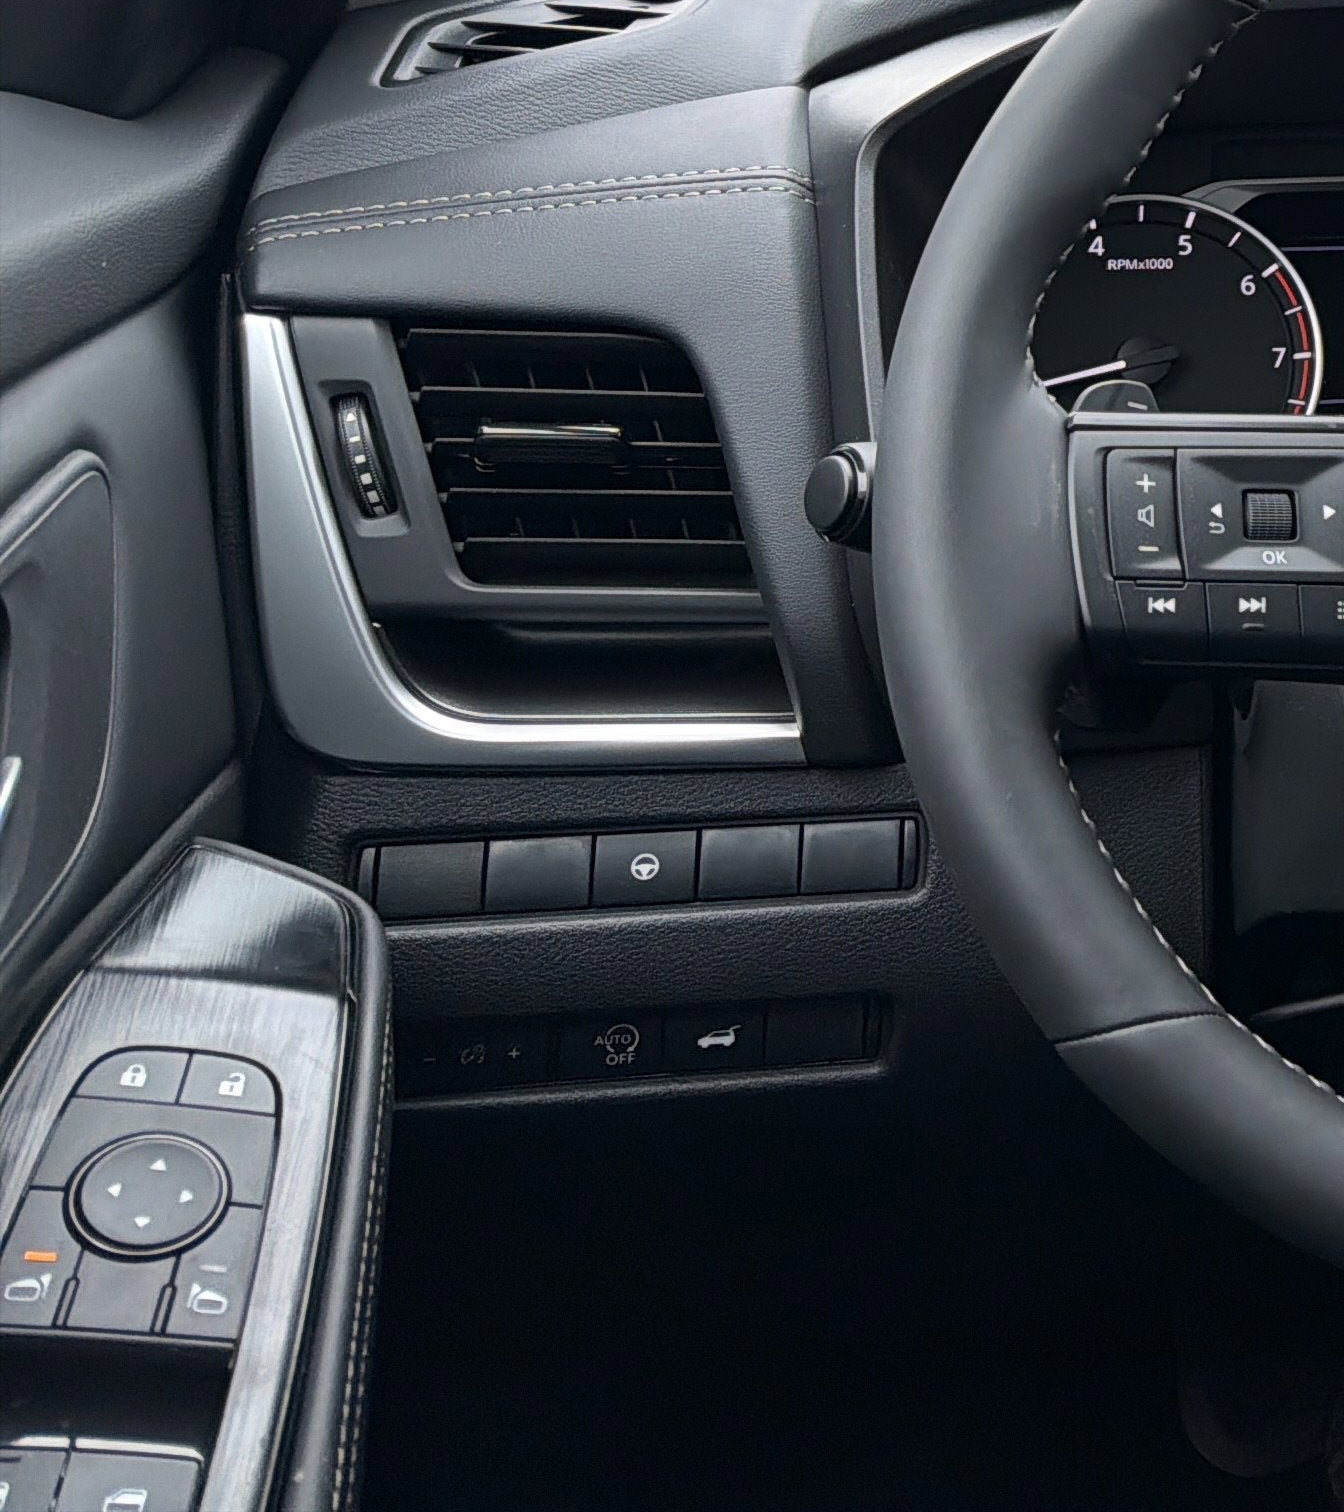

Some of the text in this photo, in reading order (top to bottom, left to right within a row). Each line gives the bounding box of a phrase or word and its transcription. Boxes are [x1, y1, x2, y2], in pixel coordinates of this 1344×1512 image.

[1088, 236, 1106, 256] 4
[1178, 235, 1192, 256] 5
[1107, 258, 1174, 270] RPMx1000
[1240, 275, 1256, 296] 6
[1272, 347, 1286, 368] 7
[1262, 550, 1288, 565] OK
[594, 1034, 632, 1046] AUTO
[606, 1053, 636, 1066] OFF
